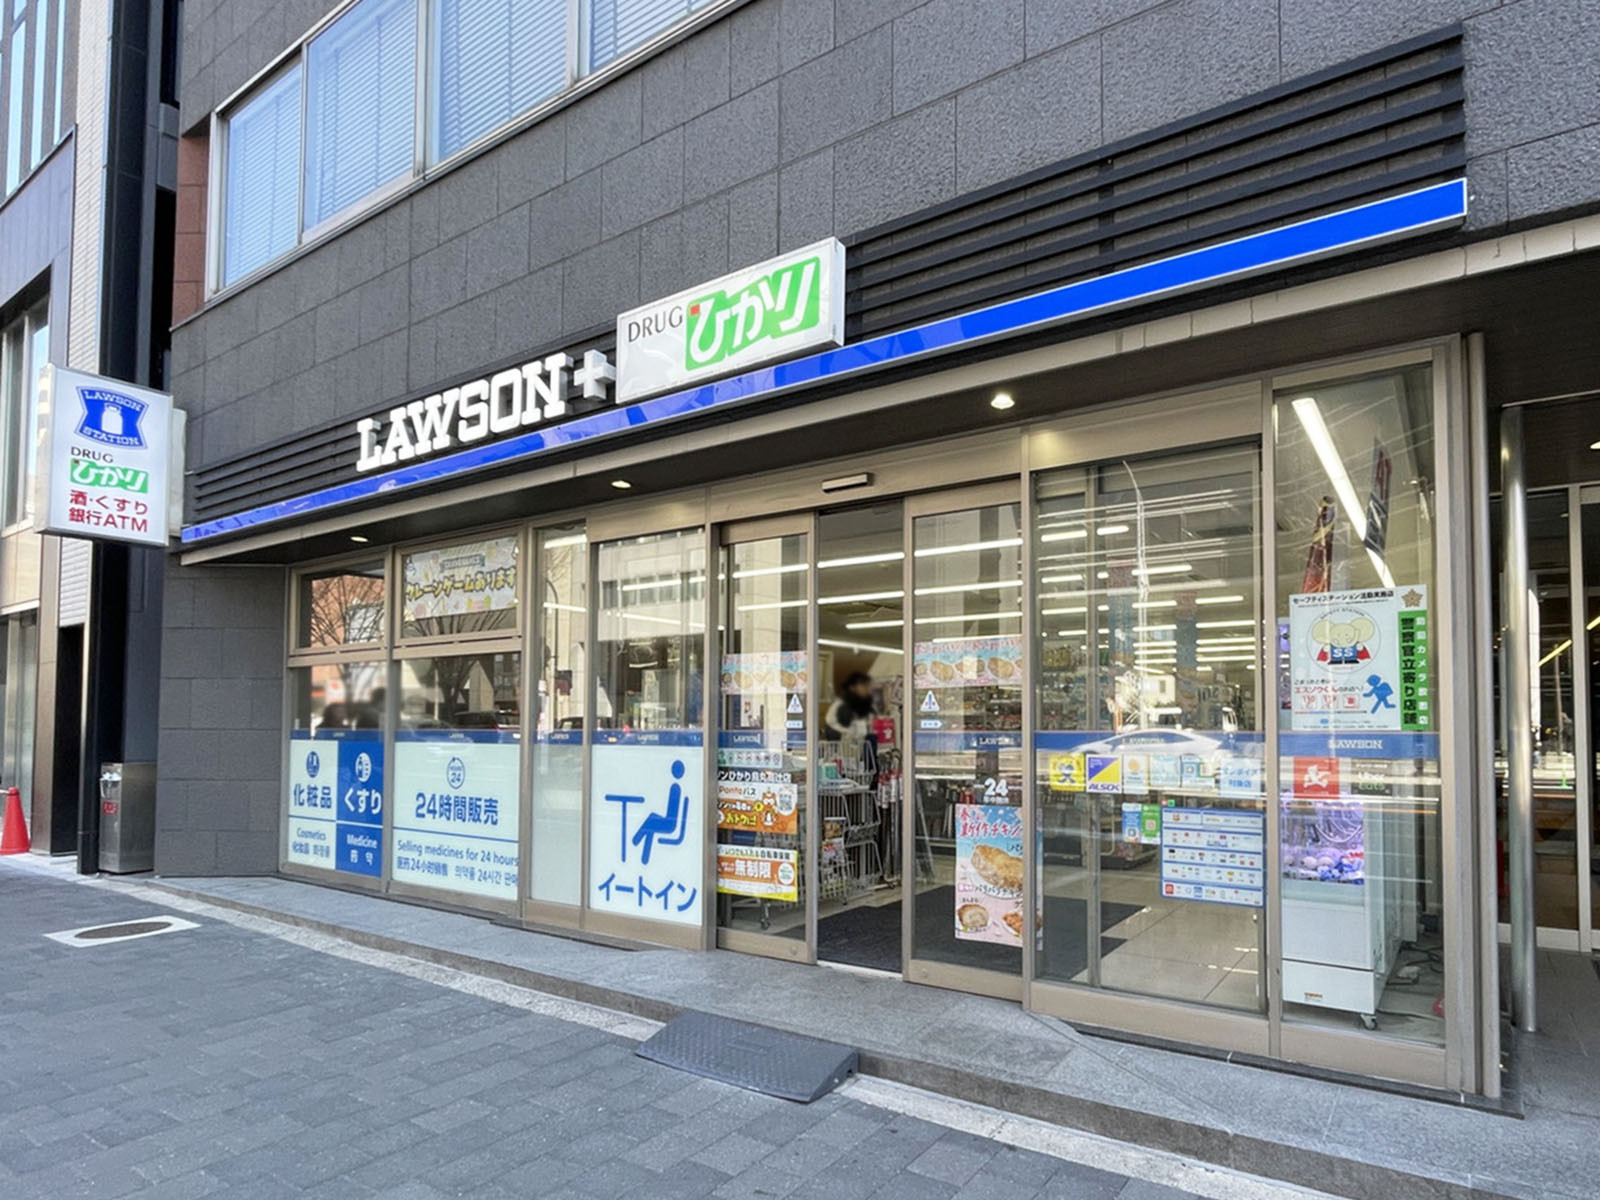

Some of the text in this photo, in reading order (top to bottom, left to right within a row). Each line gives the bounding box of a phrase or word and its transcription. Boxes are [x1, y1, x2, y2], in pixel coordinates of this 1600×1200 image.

[627, 305, 684, 344] DRUG
[84, 389, 143, 412] LAWSON
[356, 351, 572, 473] LAWSON
[81, 427, 141, 447] STATION
[70, 446, 115, 464] DRUG
[68, 507, 148, 533] 銀行ATM
[293, 783, 332, 809] 化粧品
[984, 777, 1009, 796] 24
[344, 787, 382, 815] くすり
[415, 792, 499, 826] 24時間販売
[346, 834, 378, 849] Medicine
[397, 840, 423, 857] Selling
[465, 848, 479, 861] for
[480, 850, 492, 863] 24
[598, 872, 698, 912] イートイン
